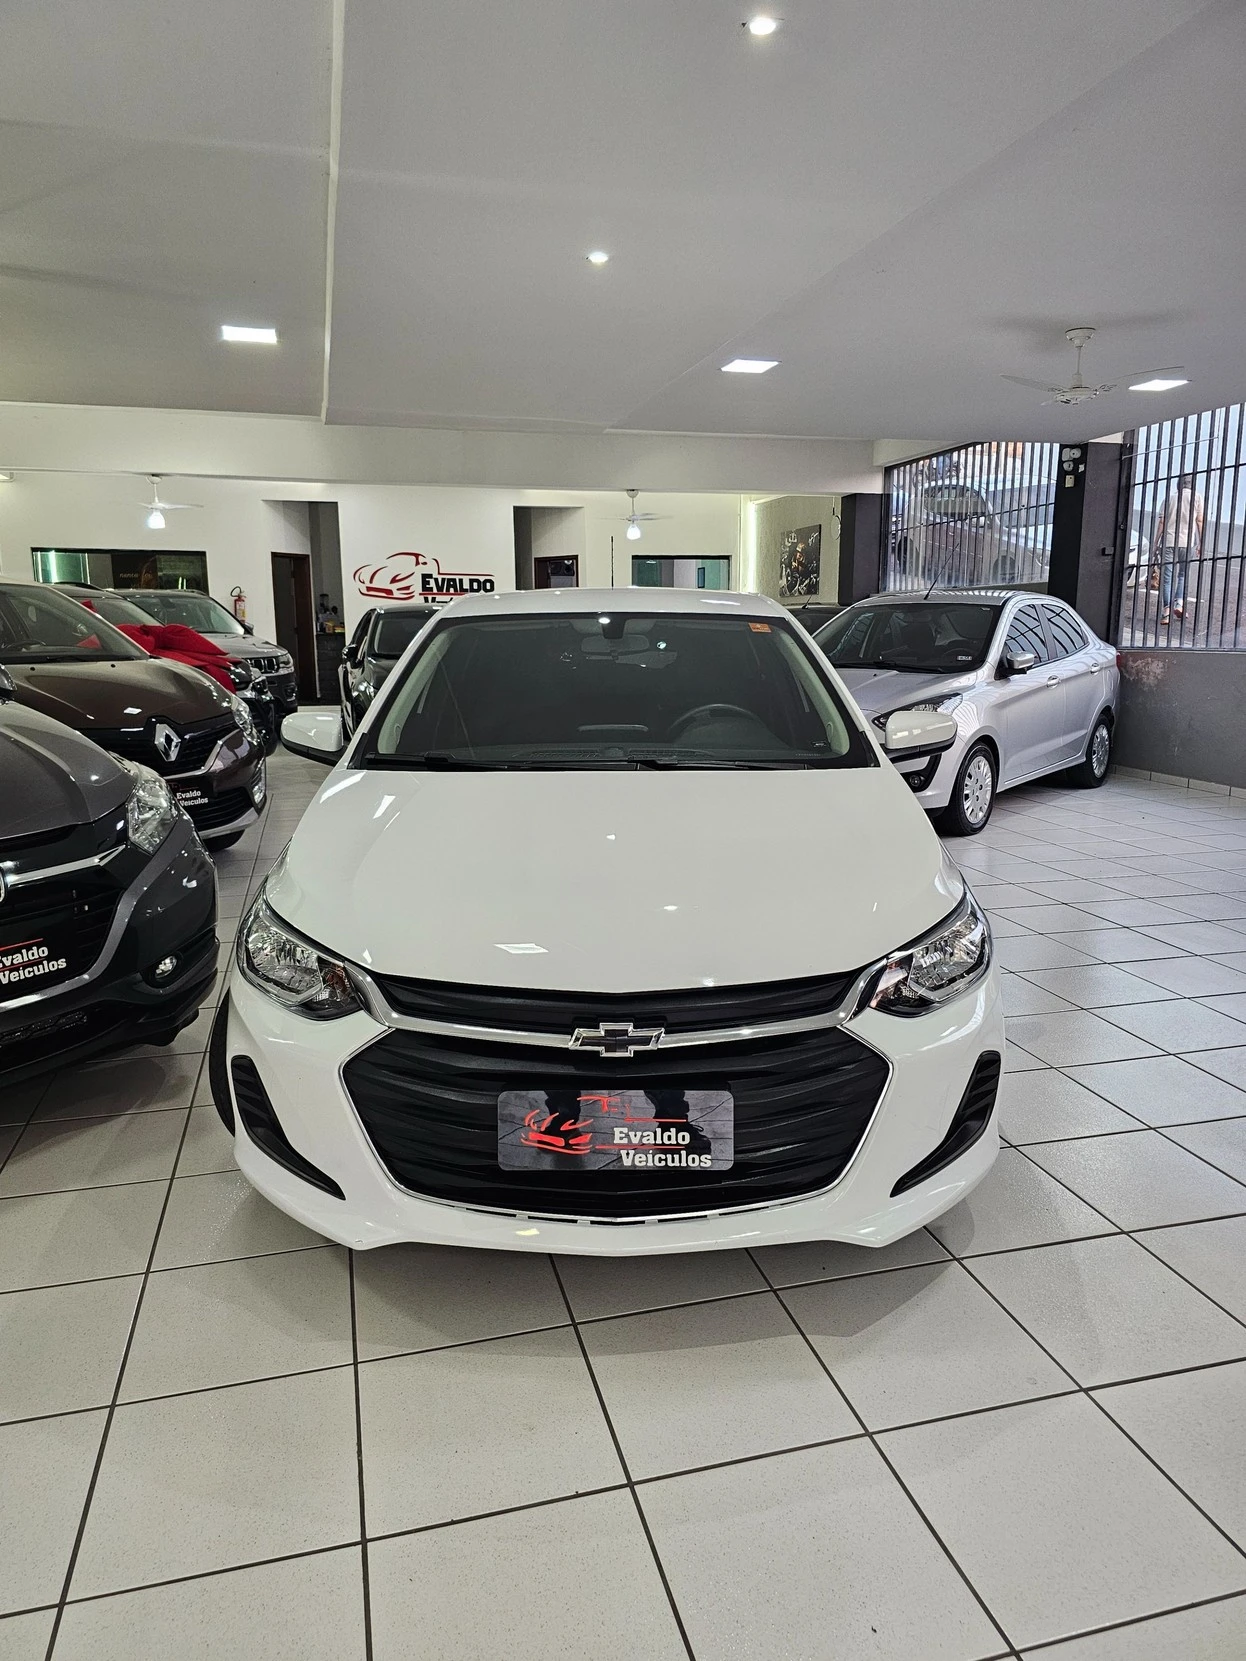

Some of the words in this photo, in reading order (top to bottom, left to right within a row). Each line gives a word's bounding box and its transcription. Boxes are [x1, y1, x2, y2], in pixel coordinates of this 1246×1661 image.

[421, 573, 495, 593] EVALDO
[176, 790, 202, 799] Evaldo
[613, 1127, 691, 1145] Evaldo
[620, 1150, 712, 1167] Veículos
